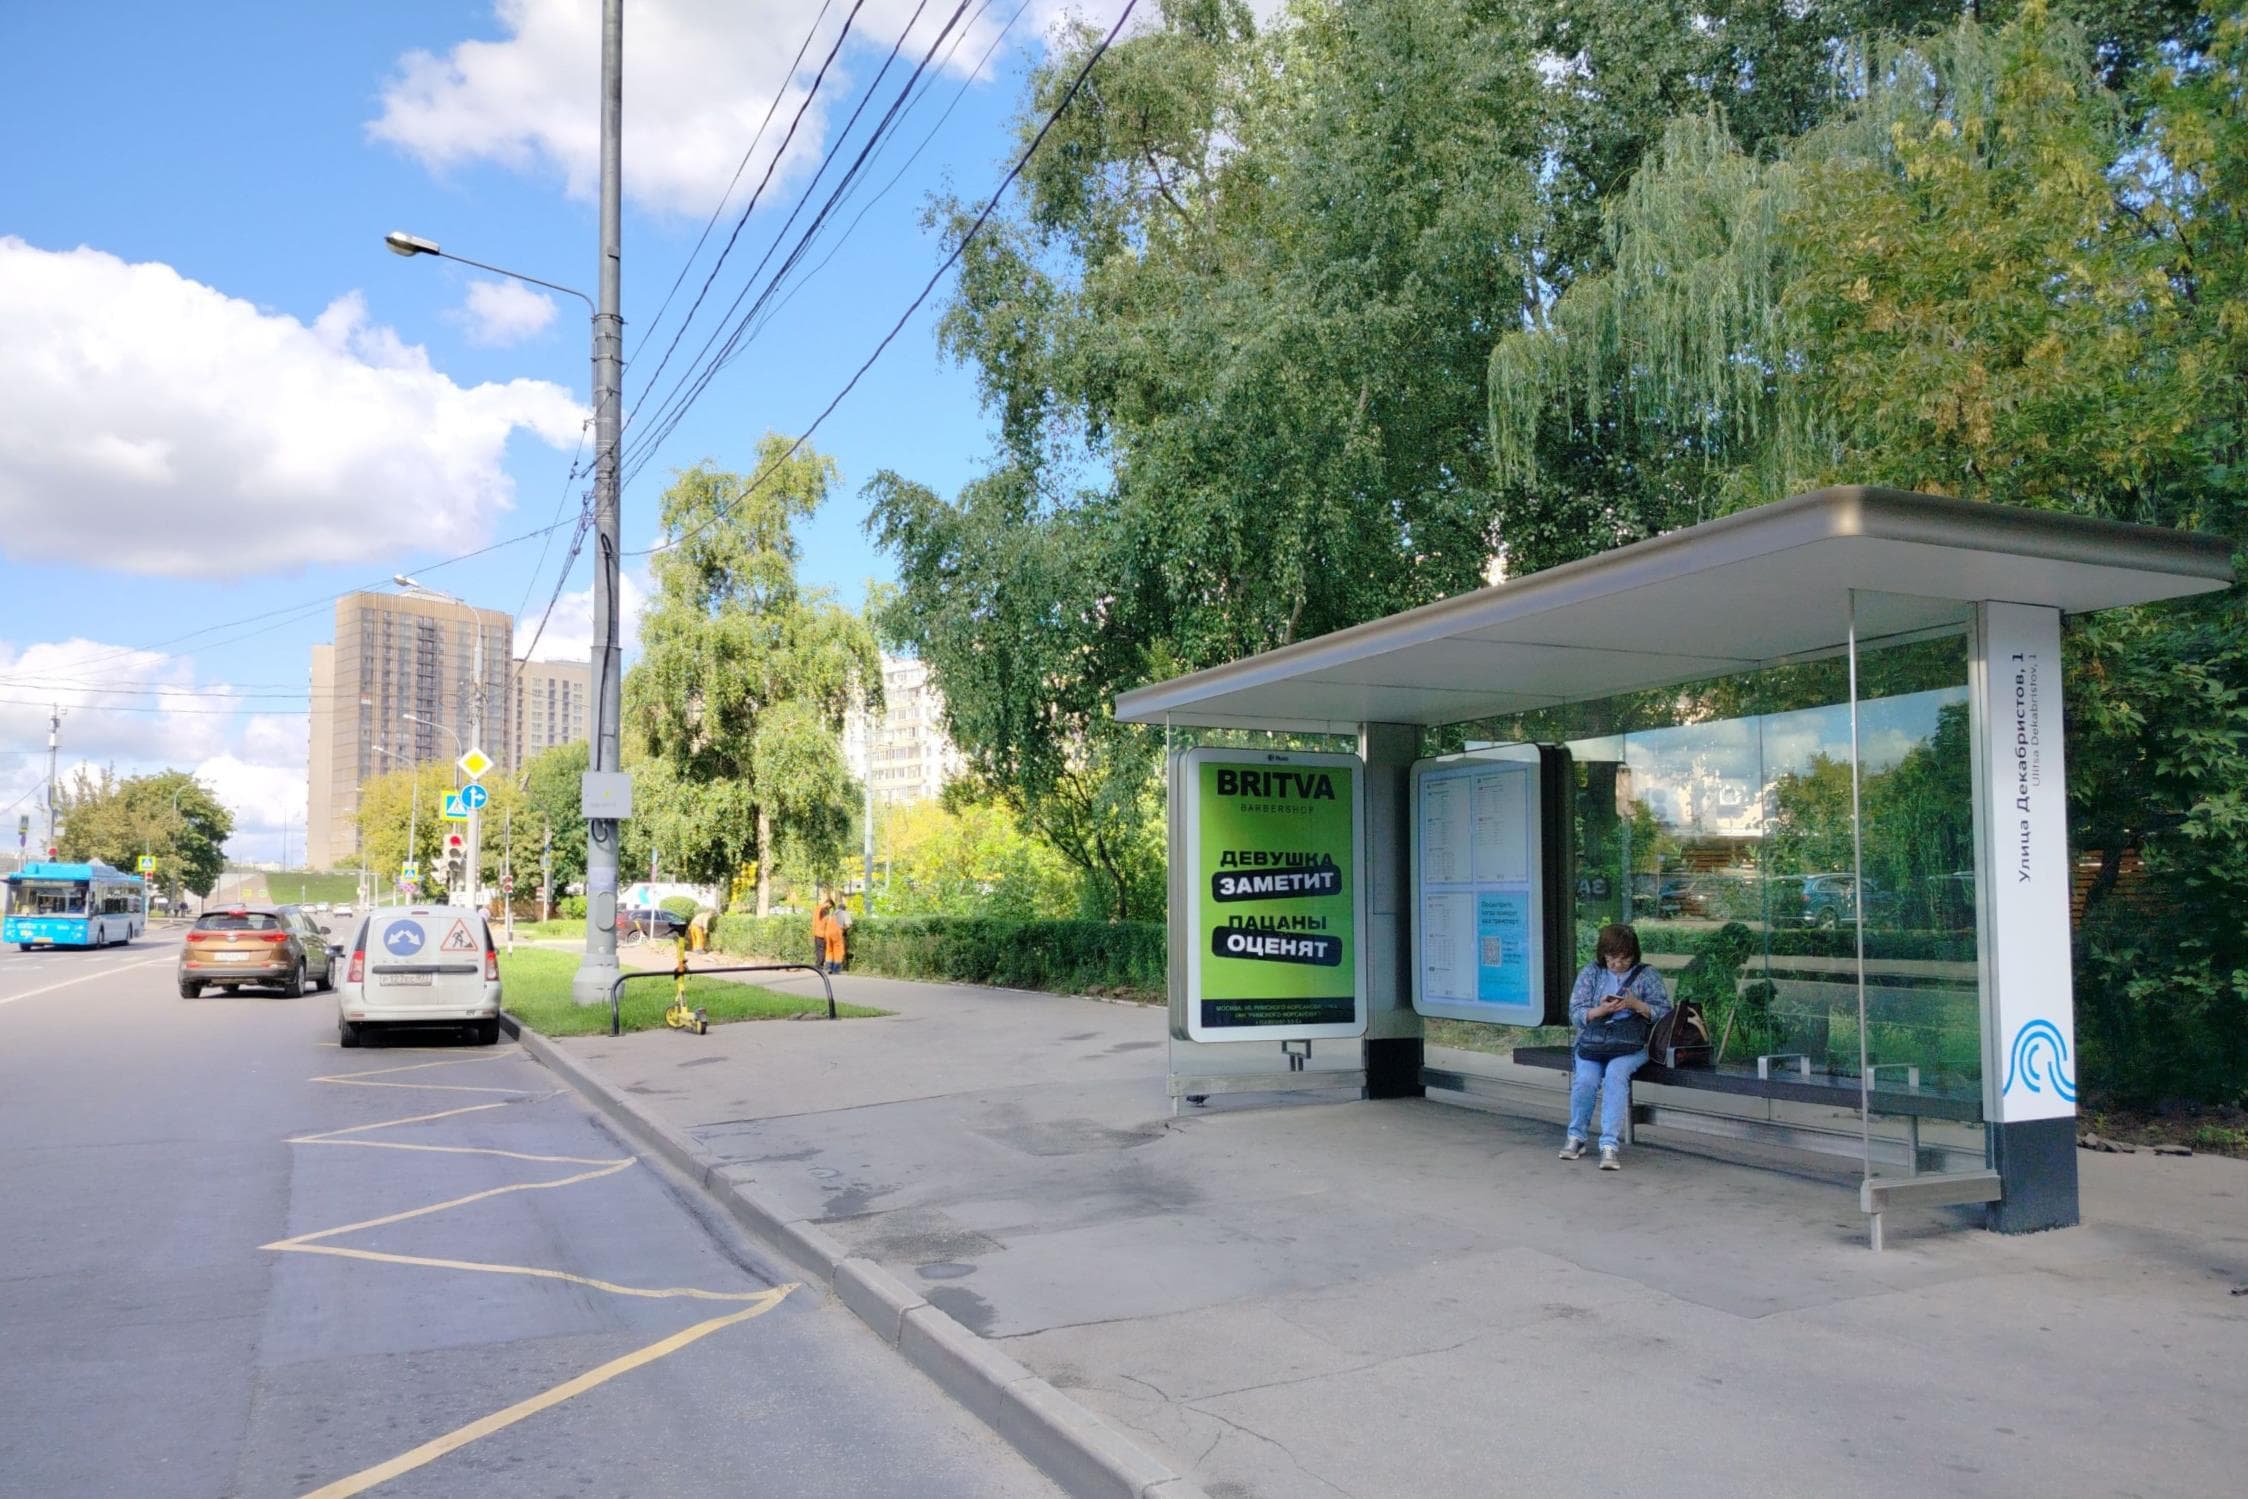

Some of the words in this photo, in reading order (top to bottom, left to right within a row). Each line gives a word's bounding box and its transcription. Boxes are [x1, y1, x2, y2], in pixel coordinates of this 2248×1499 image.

[2012, 652, 2024, 662] 1
[2029, 664, 2040, 746] Dekabristov,
[2015, 668, 2030, 812] Декабристов,
[2031, 750, 2041, 787] Ulitsa
[1217, 769, 1335, 800] BRITVA
[1240, 803, 1314, 815] BARBERSHOP
[1220, 850, 1333, 868] ДЕВУШКА
[2018, 820, 2031, 882] Улица
[1219, 872, 1334, 895] ЗАМЕТИТ
[1228, 915, 1327, 931] ПАЦАНЫ
[1227, 934, 1328, 957] ОЦЕНЯТ
